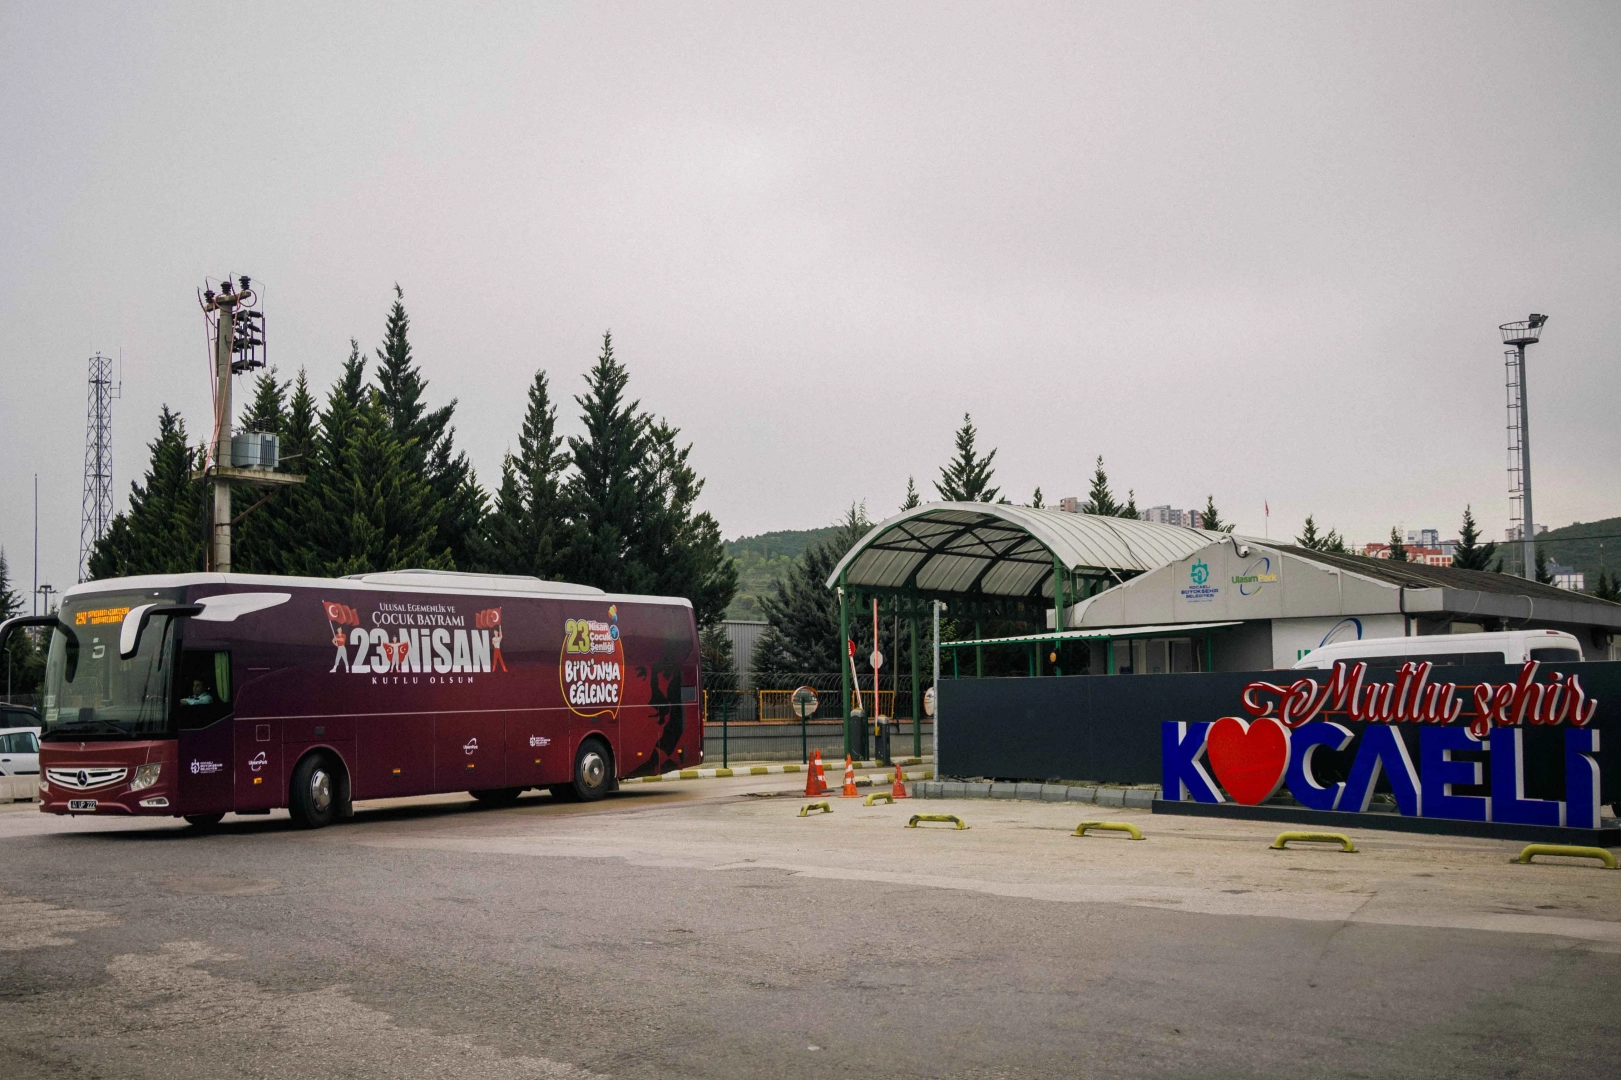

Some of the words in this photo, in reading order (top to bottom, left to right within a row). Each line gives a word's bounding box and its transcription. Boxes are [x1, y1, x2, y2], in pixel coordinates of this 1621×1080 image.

[372, 611, 415, 627] ÇOCUK
[417, 614, 465, 626] BAYRAMI
[566, 619, 590, 653] 23
[350, 628, 390, 674] 23
[372, 676, 418, 684] KUTLU
[430, 676, 474, 684] OLSUN
[569, 680, 619, 705] EĞLENCE
[1241, 661, 1463, 728] Mutlu
